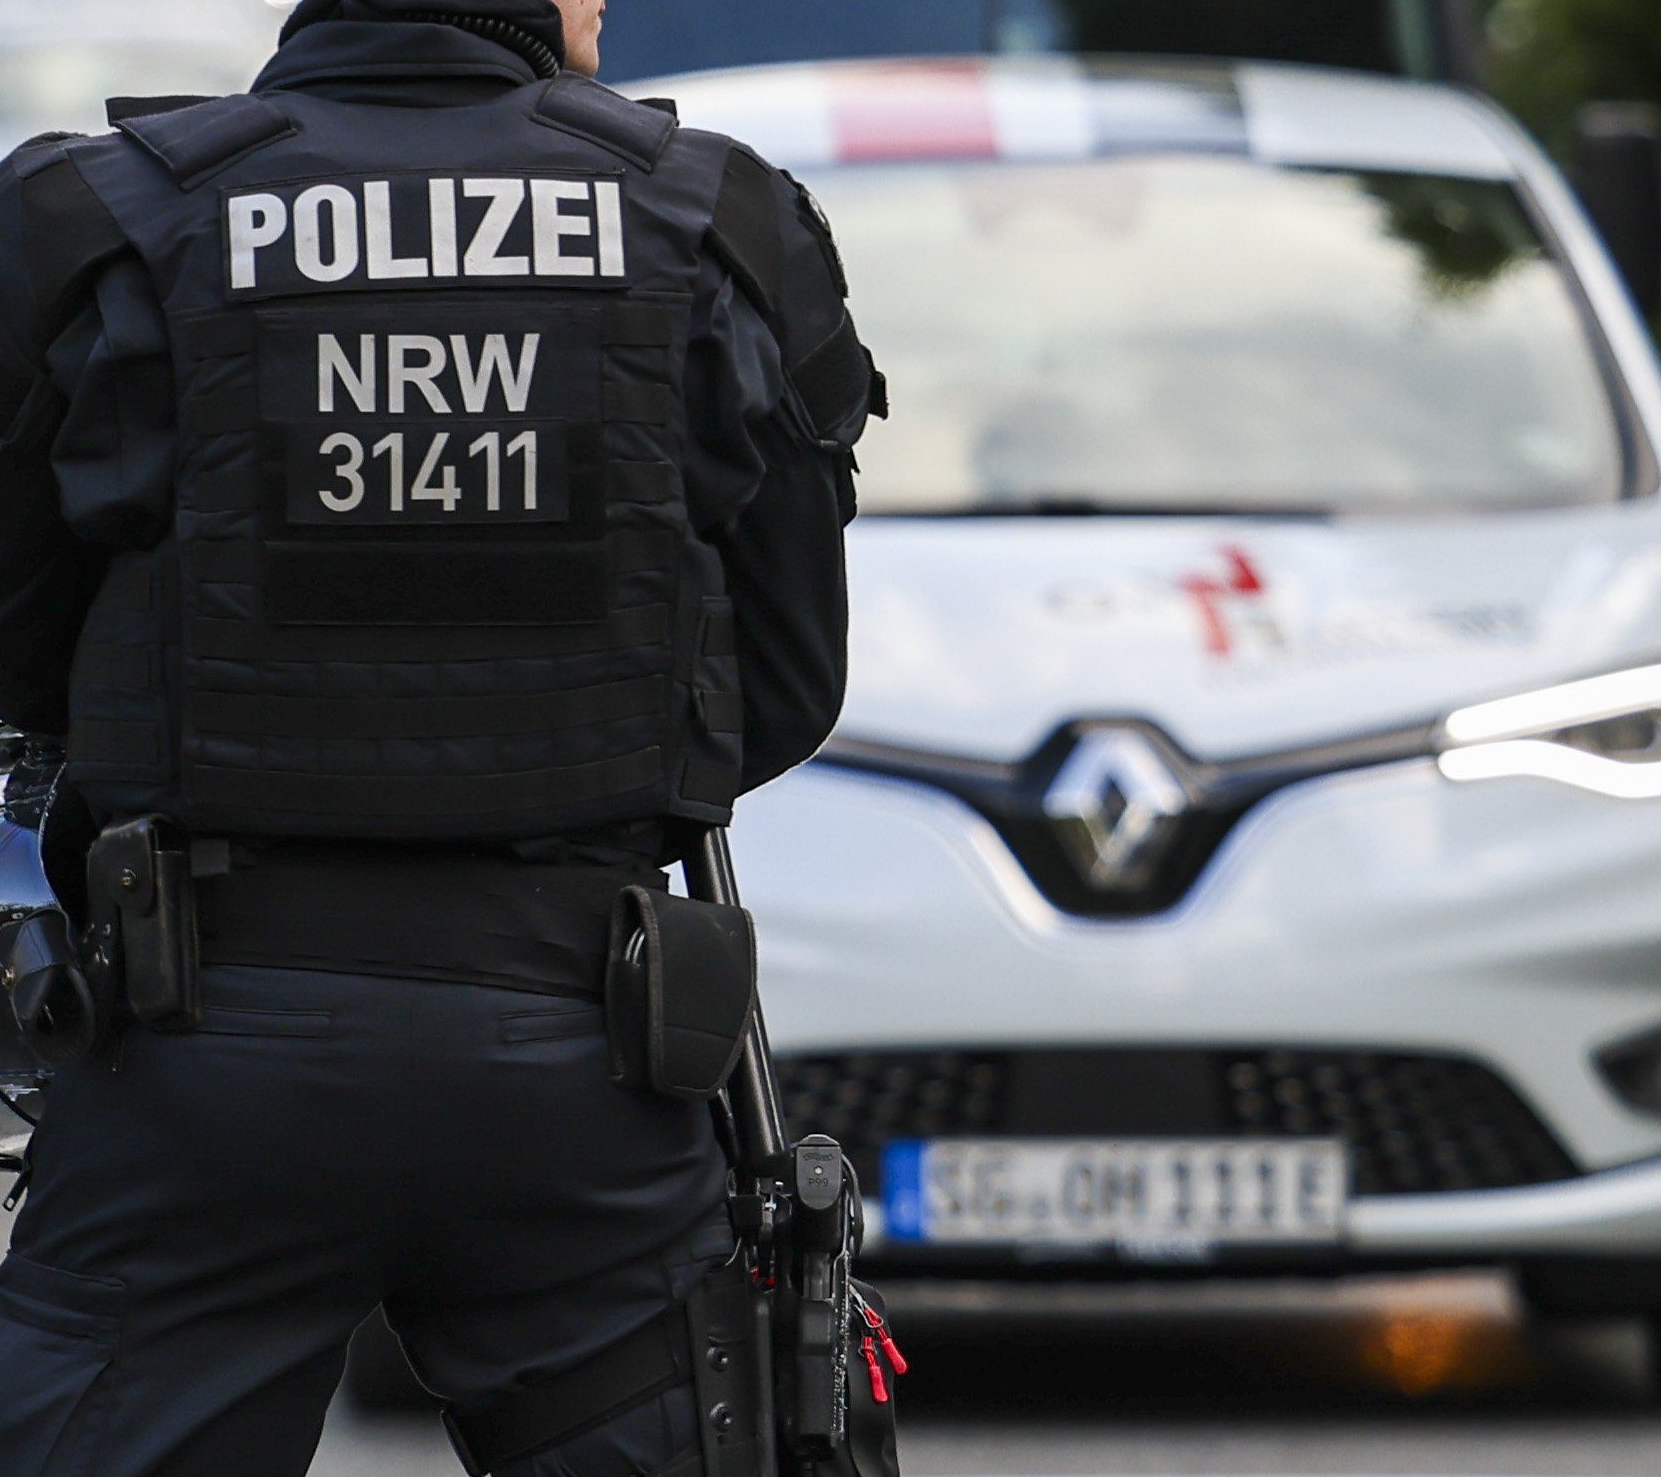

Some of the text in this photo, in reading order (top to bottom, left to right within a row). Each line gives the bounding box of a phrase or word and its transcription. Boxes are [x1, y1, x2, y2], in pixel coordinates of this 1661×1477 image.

[228, 178, 625, 289] POLIZEI
[319, 334, 540, 413] NRW
[319, 431, 536, 511] 31411
